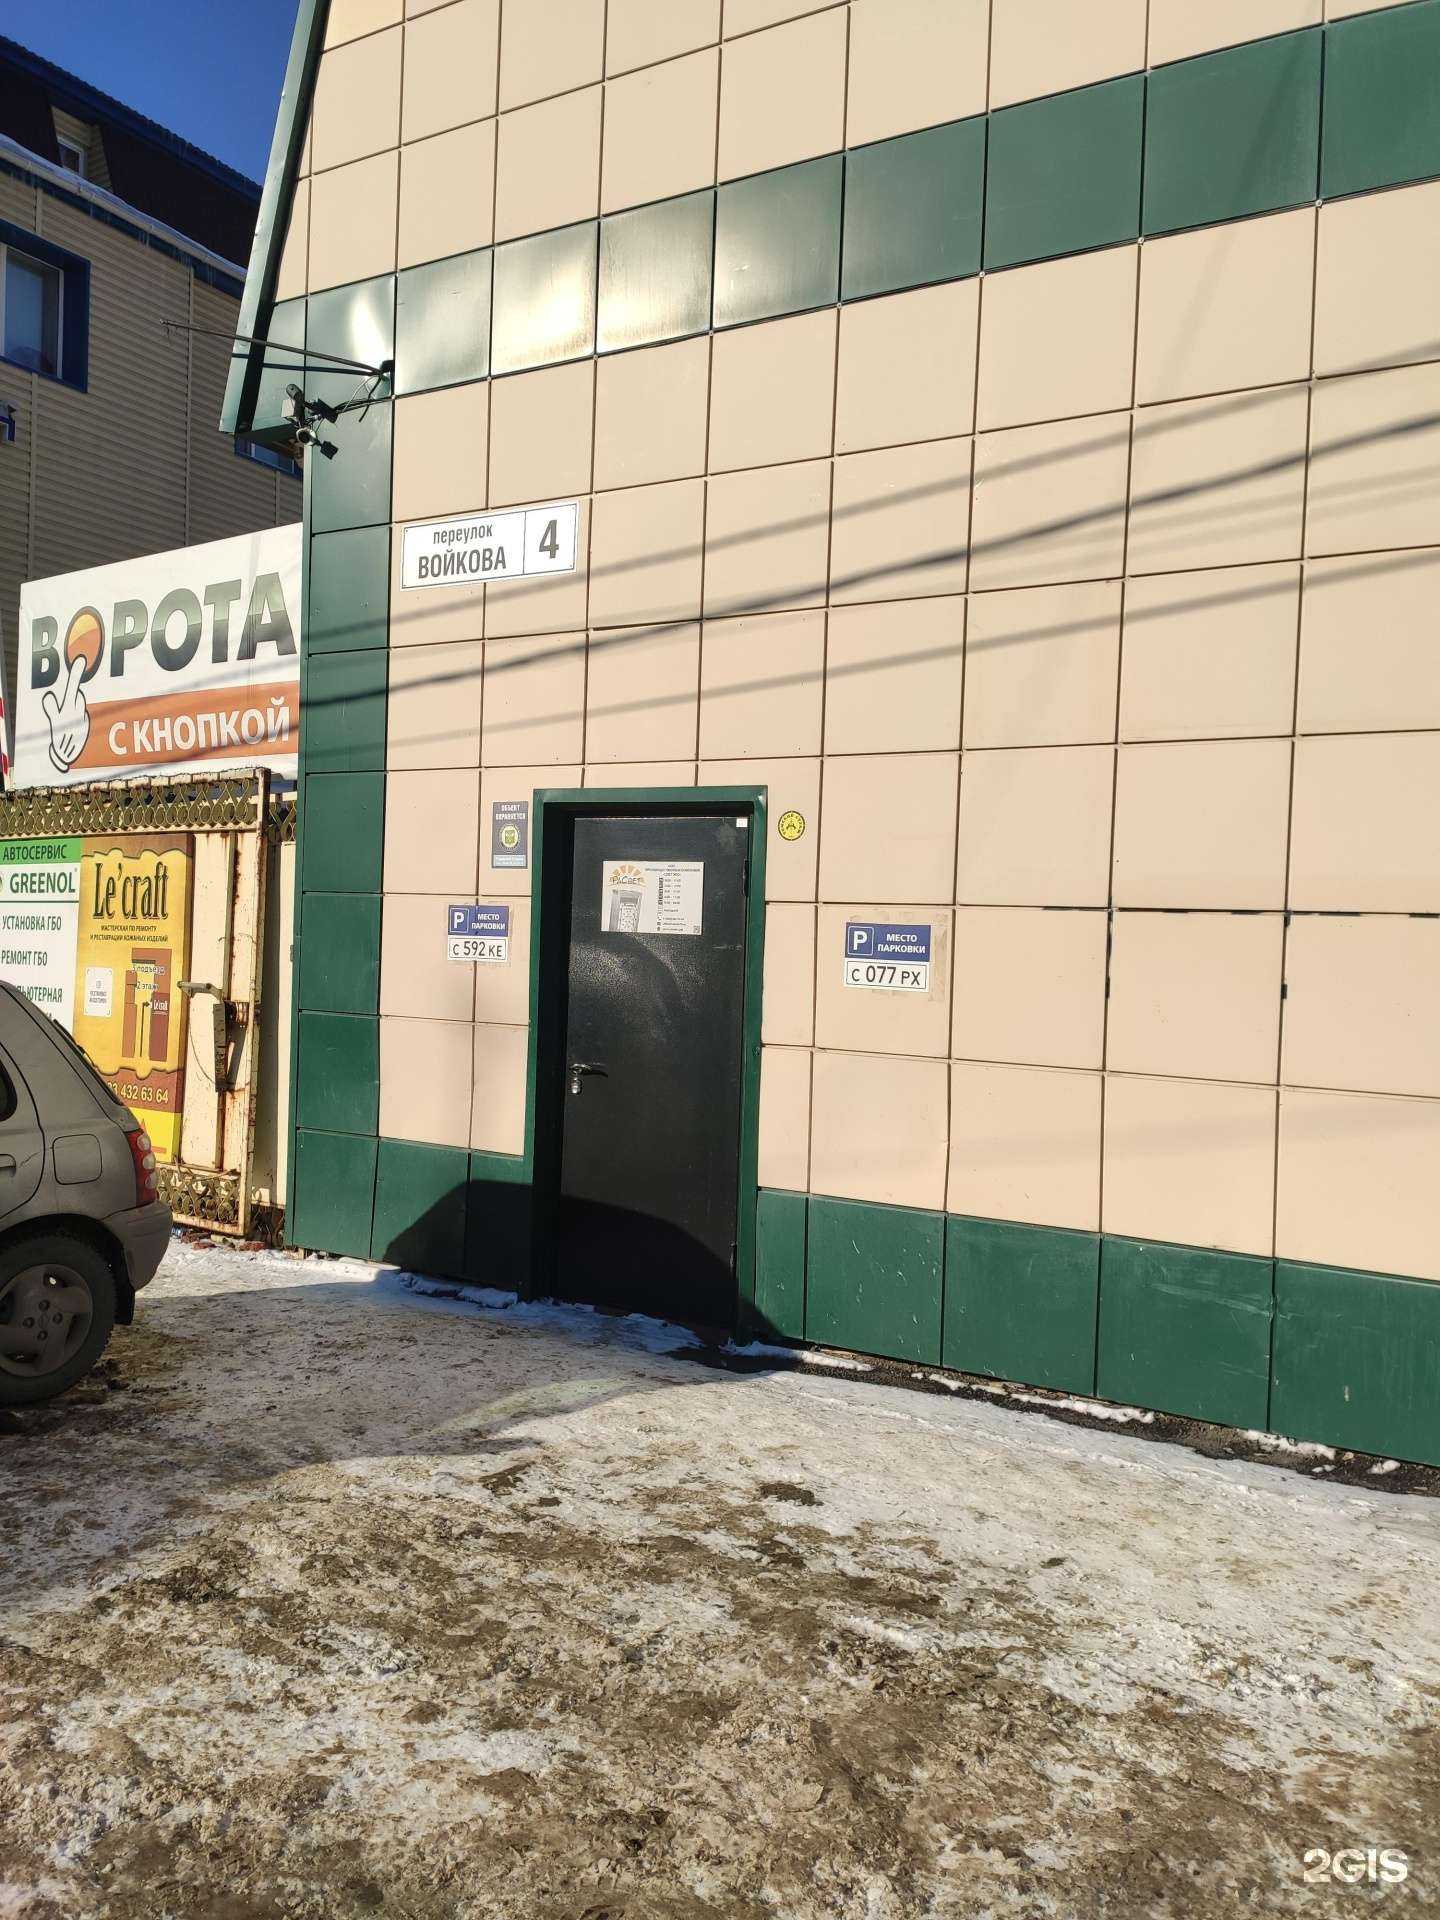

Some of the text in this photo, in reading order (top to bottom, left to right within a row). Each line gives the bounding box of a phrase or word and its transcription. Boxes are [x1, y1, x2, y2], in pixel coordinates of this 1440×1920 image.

[433, 523, 493, 546] переулок
[538, 519, 560, 559] 4
[418, 546, 507, 579] ВОЙКОВА
[31, 572, 297, 690] ВОРОТА
[108, 696, 290, 756] С КНОПКОЙ
[3, 845, 67, 860] АВТОСЕРВИС
[10, 872, 76, 893] GREENOL
[2, 916, 62, 930] УСТАНОВКА ГБО
[471, 922, 506, 930] ПАРКОВКИ
[477, 913, 500, 921] МЕСТО
[886, 933, 918, 943] МЕСТО
[1, 950, 48, 966] РЕМОНТ ГБО
[877, 944, 926, 954] ПАРКОВКИ
[866, 965, 897, 984] 077
[120, 1084, 139, 1100] 432
[141, 1086, 153, 1102] 63
[156, 1089, 169, 1104] 64
